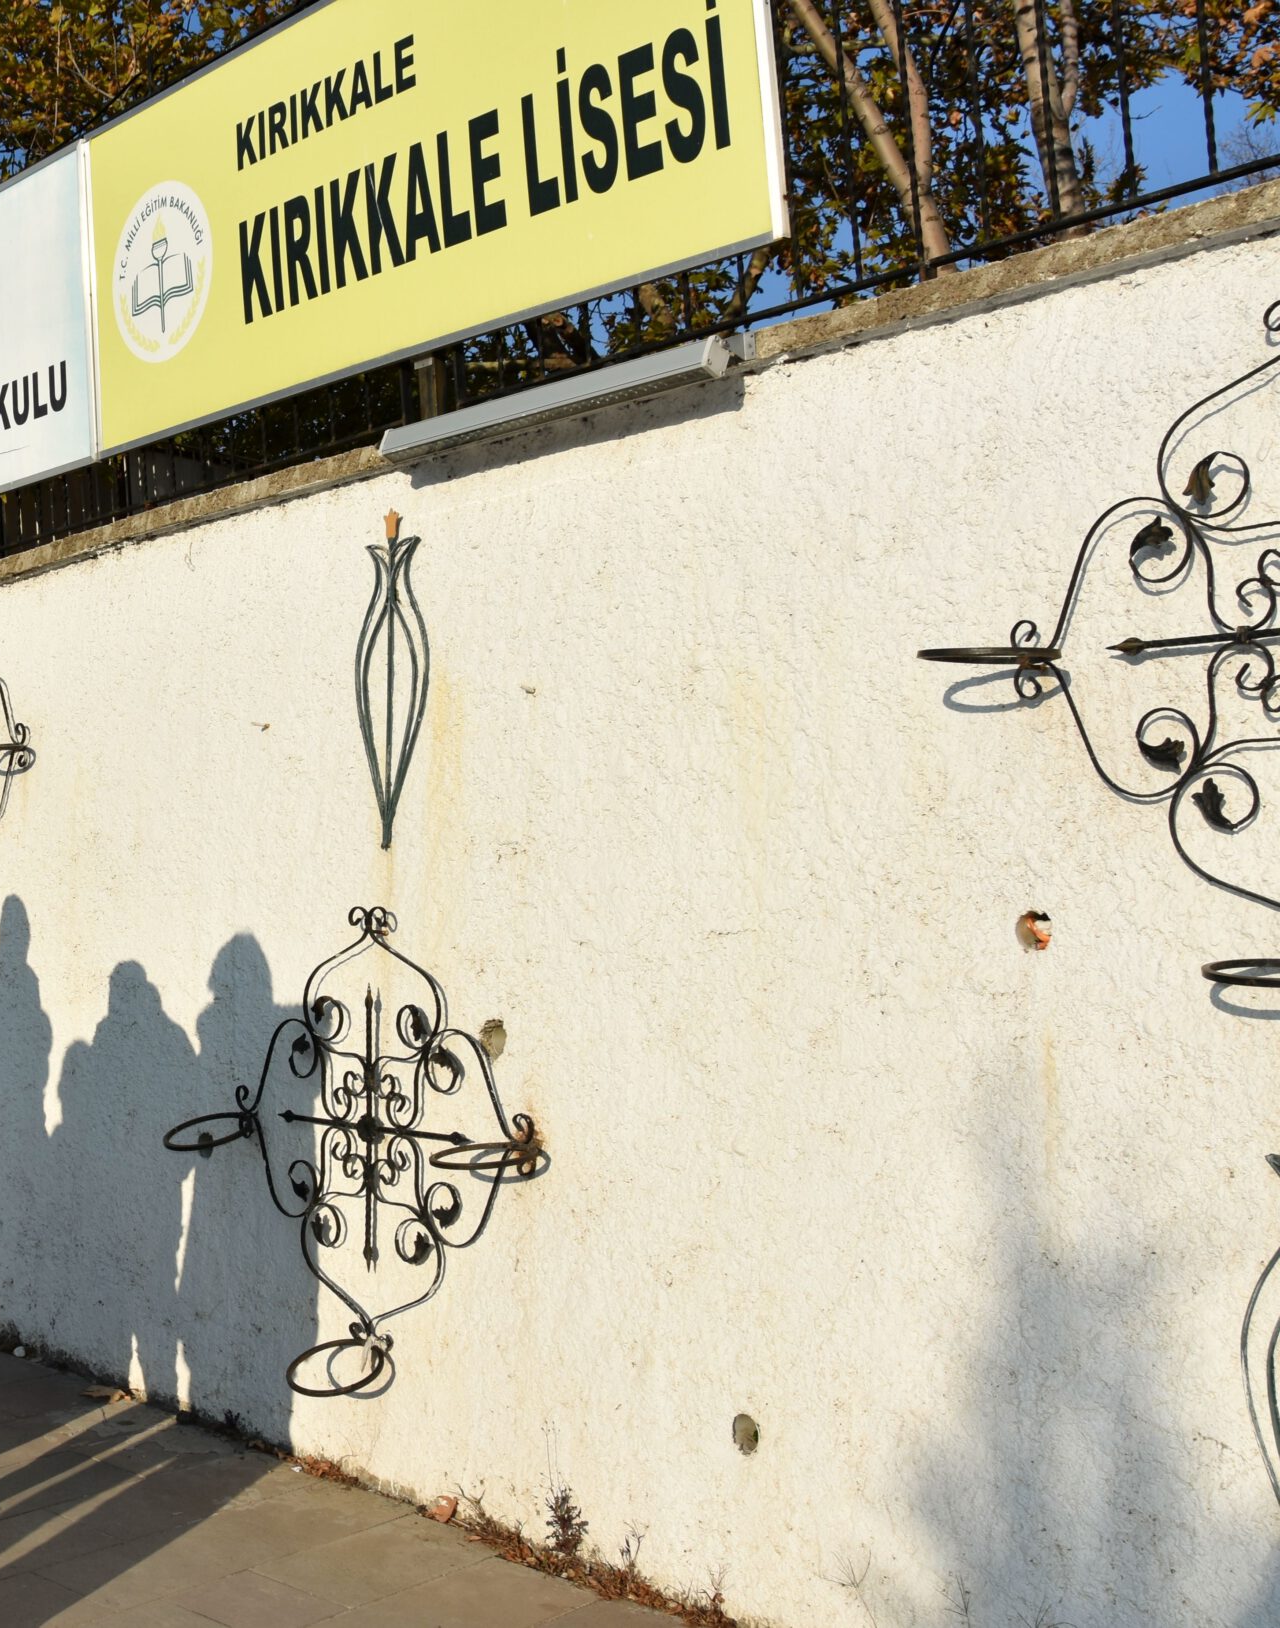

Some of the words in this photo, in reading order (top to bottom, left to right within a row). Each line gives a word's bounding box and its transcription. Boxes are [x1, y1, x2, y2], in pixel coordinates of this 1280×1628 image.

[235, 34, 417, 171] KIRIKKALE
[238, 109, 507, 325] KIRIKKALE
[521, 0, 731, 217] LİSESİ
[125, 216, 141, 252] MİLLİ
[140, 194, 168, 222] EĞİTİM
[169, 195, 204, 246] BAKANLIĞI
